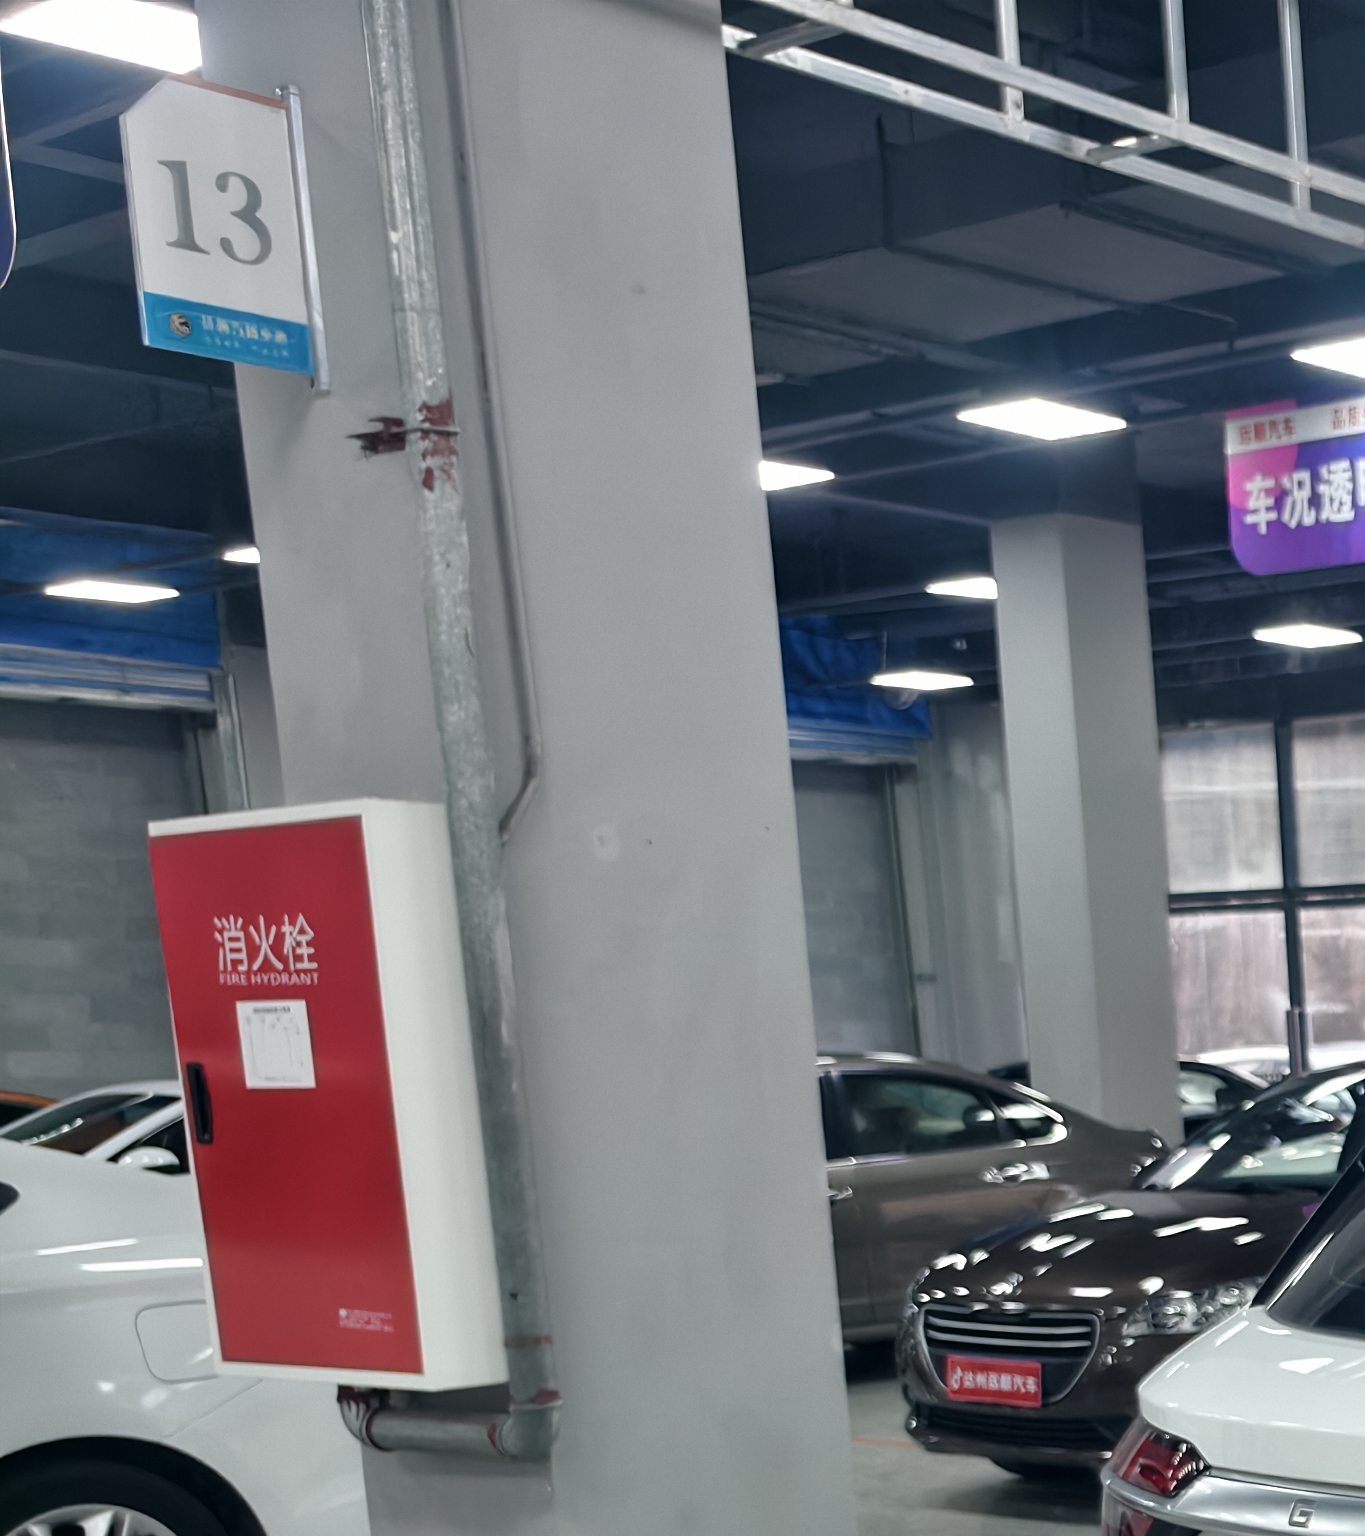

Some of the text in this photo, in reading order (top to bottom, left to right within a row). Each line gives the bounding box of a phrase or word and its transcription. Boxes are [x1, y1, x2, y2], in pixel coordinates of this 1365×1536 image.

[157, 159, 272, 266] 13
[213, 912, 318, 972] 消火栓
[219, 972, 319, 986] FIRE HYDRANT
